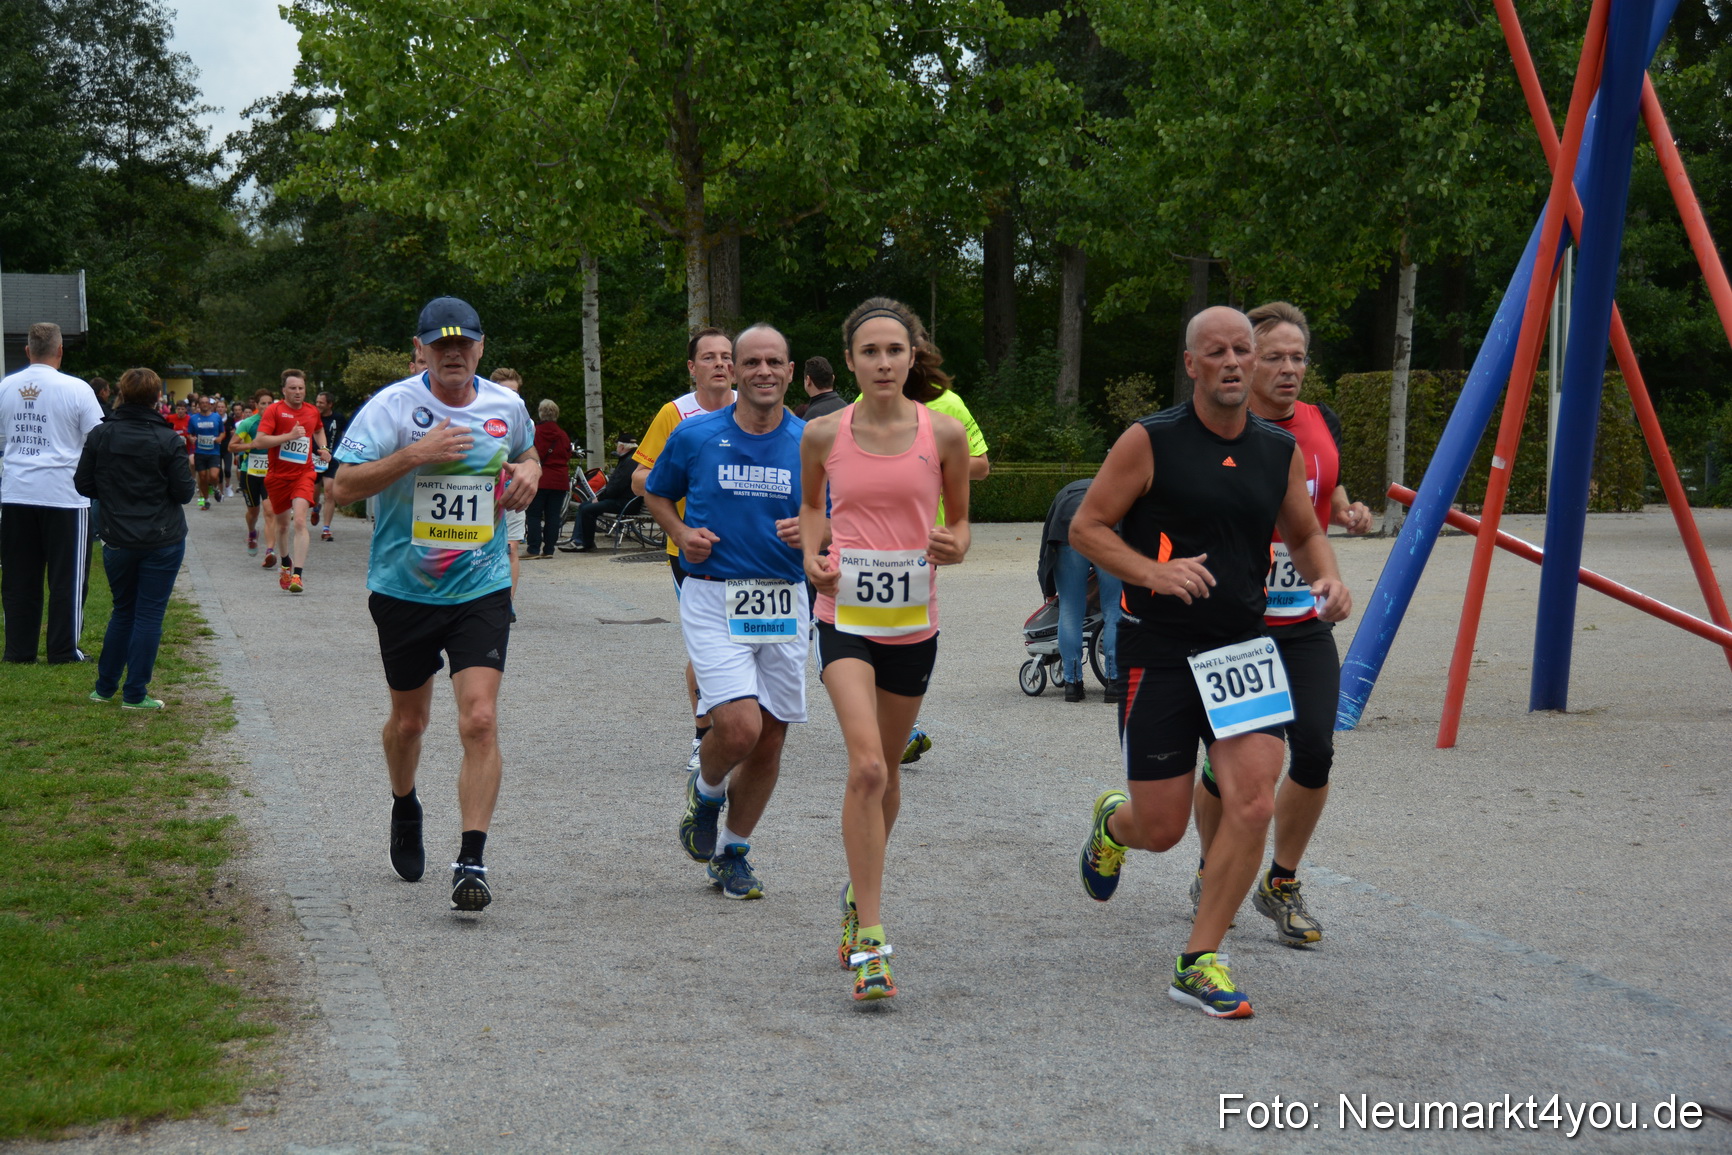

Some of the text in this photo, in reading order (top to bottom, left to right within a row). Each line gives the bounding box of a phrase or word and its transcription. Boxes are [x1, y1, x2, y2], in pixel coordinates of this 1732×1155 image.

[25, 401, 34, 409] IM
[18, 447, 40, 456] JESUS
[283, 441, 308, 454] 3022
[718, 464, 792, 486] HUBER
[416, 482, 482, 491] PARTL Neumarkt
[733, 482, 789, 492] TECHNOLOGY
[431, 493, 478, 521] 341
[429, 527, 478, 540] Karlheinz
[841, 556, 914, 567] PARTL Neumarkt
[727, 579, 754, 587] PARTL
[856, 571, 910, 603] 531
[734, 588, 791, 615] 2310
[743, 622, 785, 633] Bernhard
[1193, 647, 1263, 671] PARTL Neumarkt
[1206, 658, 1276, 703] 3097
